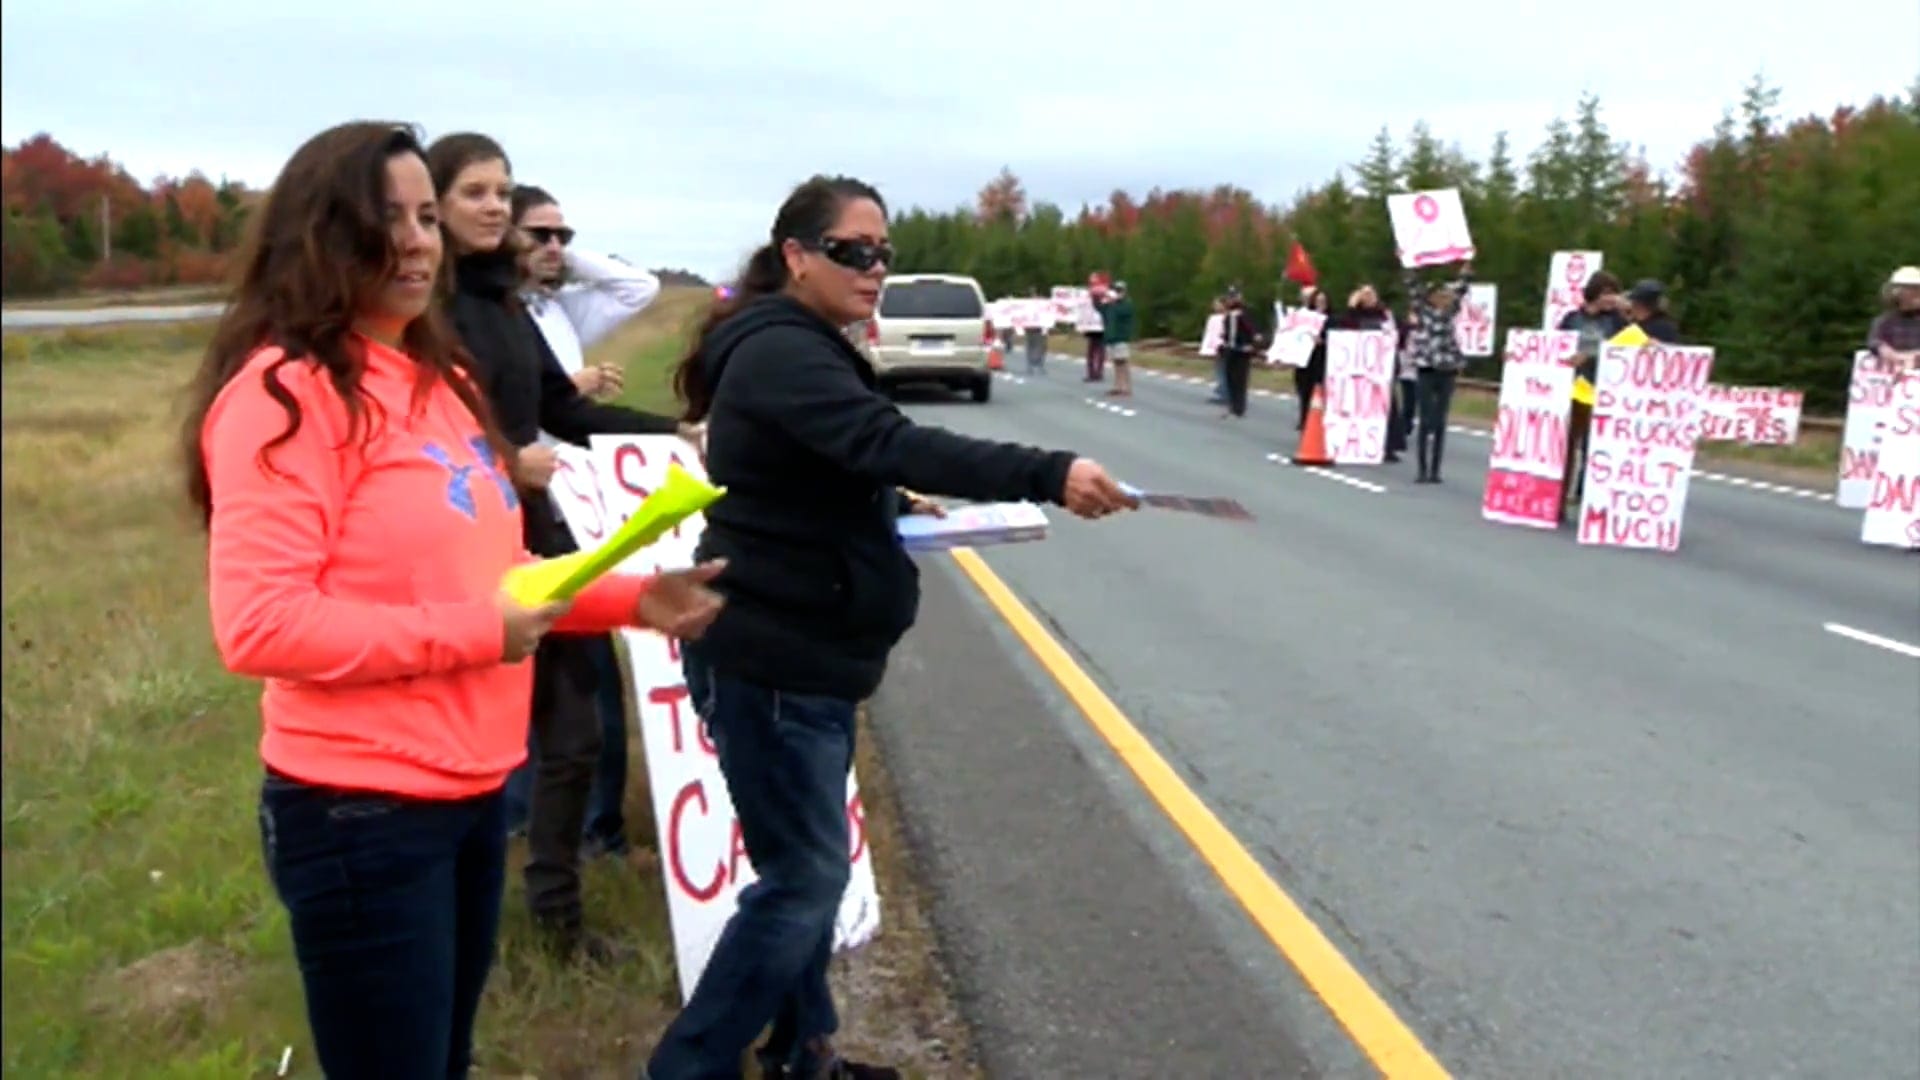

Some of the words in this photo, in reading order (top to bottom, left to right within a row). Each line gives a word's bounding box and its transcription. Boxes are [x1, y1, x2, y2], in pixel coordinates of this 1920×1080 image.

[1509, 329, 1575, 367] SAVE
[1598, 390, 1696, 418] DUMP
[1592, 414, 1698, 451] TRUCKS
[1590, 450, 1682, 488] SALT
[1611, 489, 1668, 515] TOO
[1583, 505, 1677, 549] MUCH
